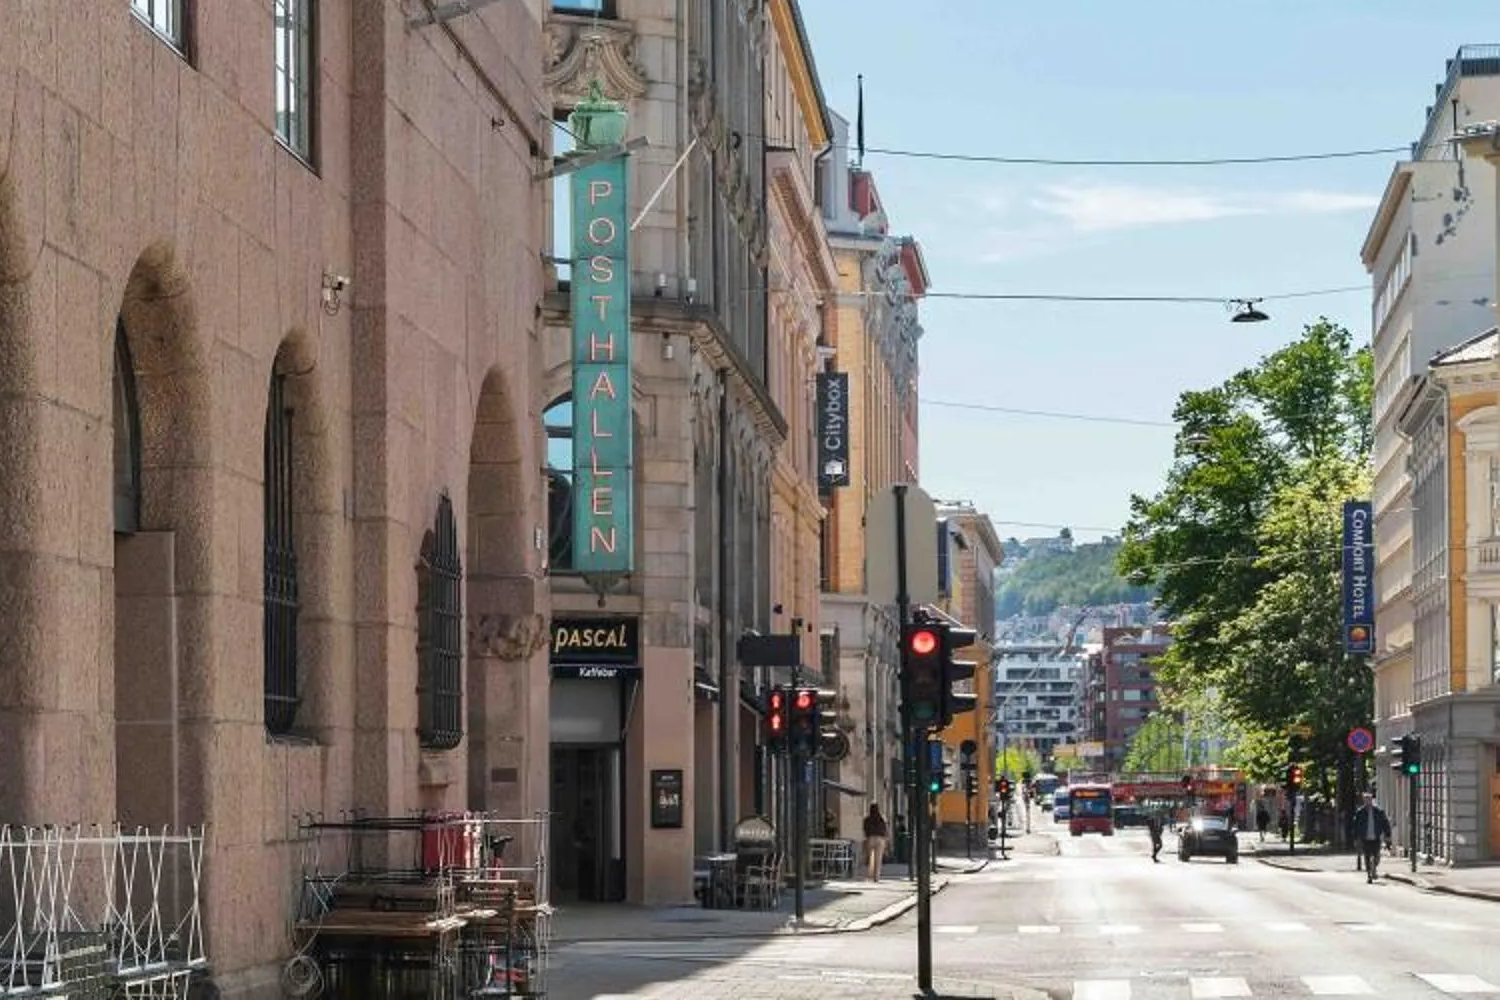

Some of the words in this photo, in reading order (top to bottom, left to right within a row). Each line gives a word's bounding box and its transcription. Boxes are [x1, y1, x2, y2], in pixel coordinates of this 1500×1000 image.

[587, 180, 617, 553] POSTHALLEN
[825, 379, 845, 451] Citybox
[1352, 509, 1368, 572] COMFORT
[1352, 576, 1367, 619] HOTEL
